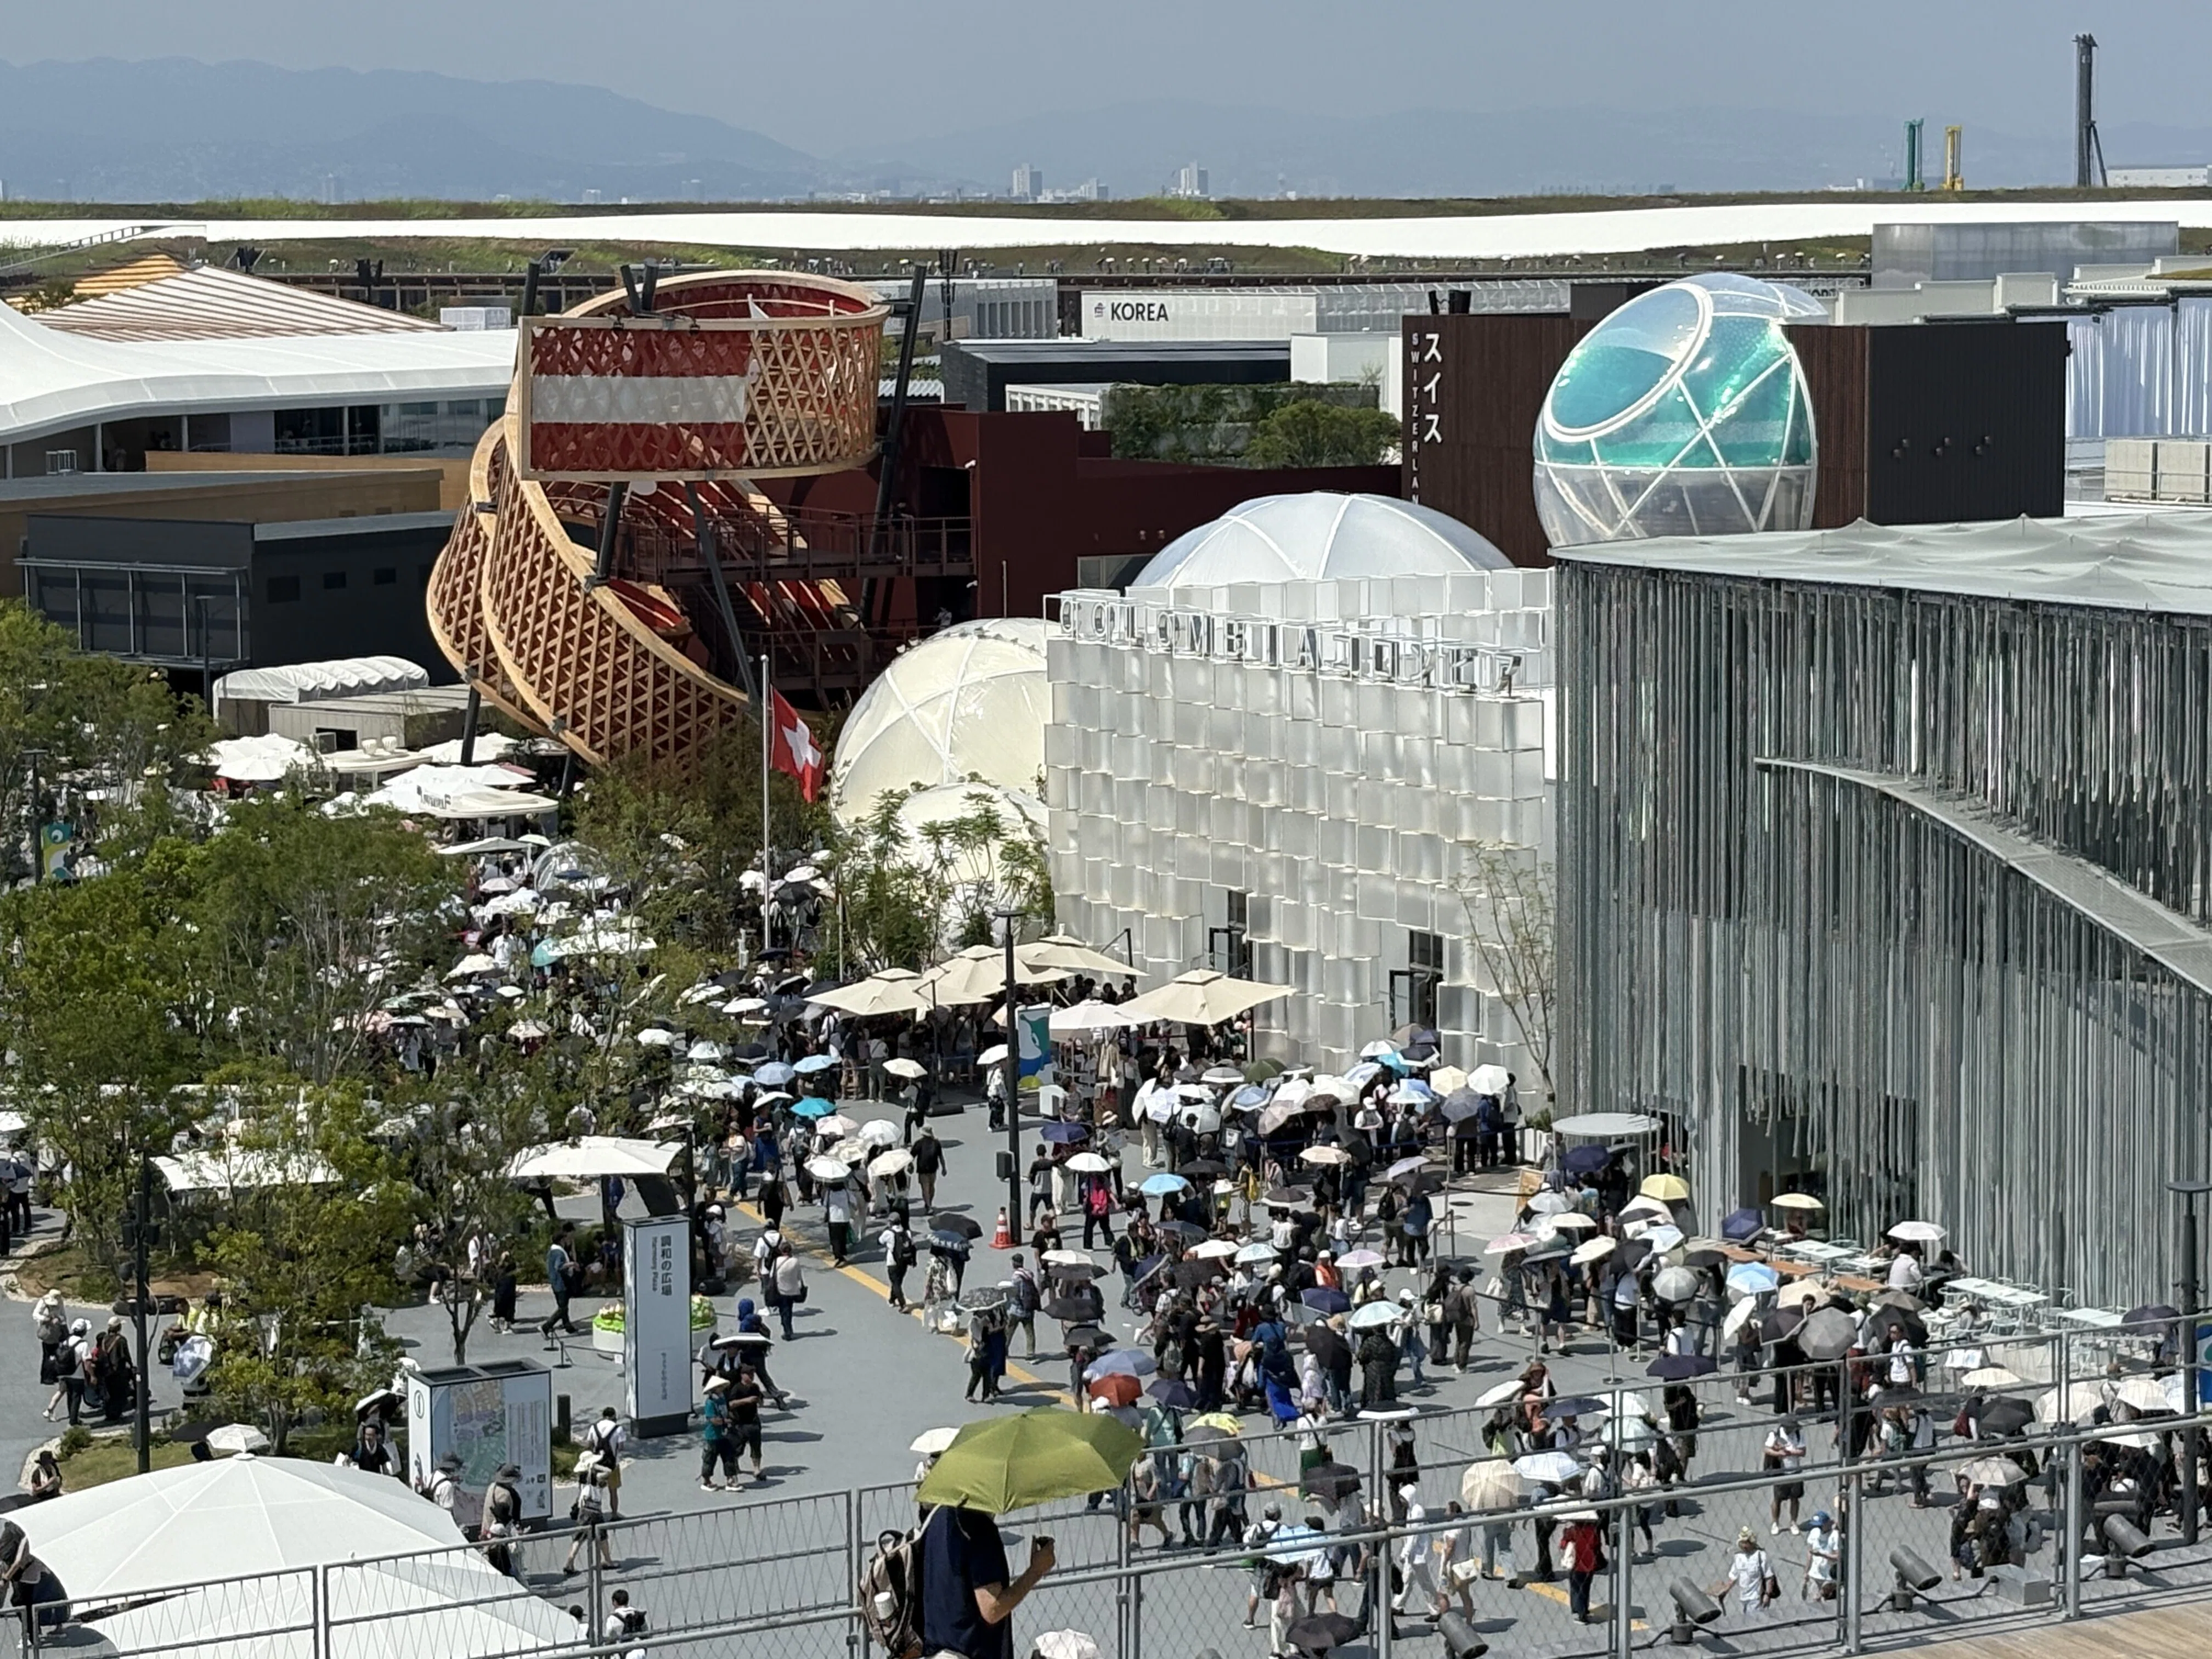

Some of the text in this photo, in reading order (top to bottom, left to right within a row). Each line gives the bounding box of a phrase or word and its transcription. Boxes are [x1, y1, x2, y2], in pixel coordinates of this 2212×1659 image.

[1111, 302, 1169, 321] KOREA
[1410, 332, 1420, 505] SWITZERLAN
[1424, 333, 1442, 443] スイス
[1060, 600, 1319, 669] COLOMBIA
